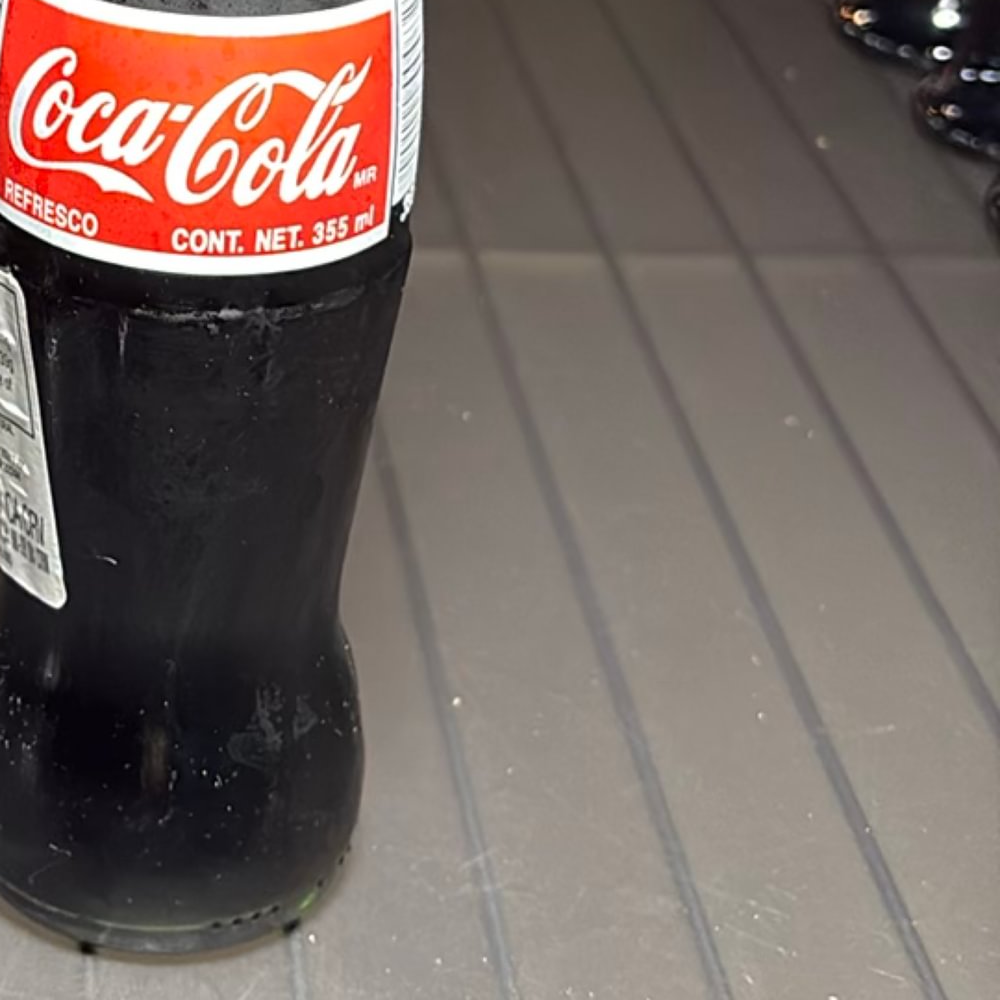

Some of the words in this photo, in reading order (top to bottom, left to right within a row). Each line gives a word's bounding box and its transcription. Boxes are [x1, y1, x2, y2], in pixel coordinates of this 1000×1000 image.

[8, 46, 373, 207] Coca-Cola
[352, 165, 378, 190] MR
[4, 177, 99, 238] REFRESCO
[171, 227, 245, 254] CONT.
[255, 223, 305, 252] NET.
[312, 214, 349, 245] 355
[354, 203, 376, 233] ml
